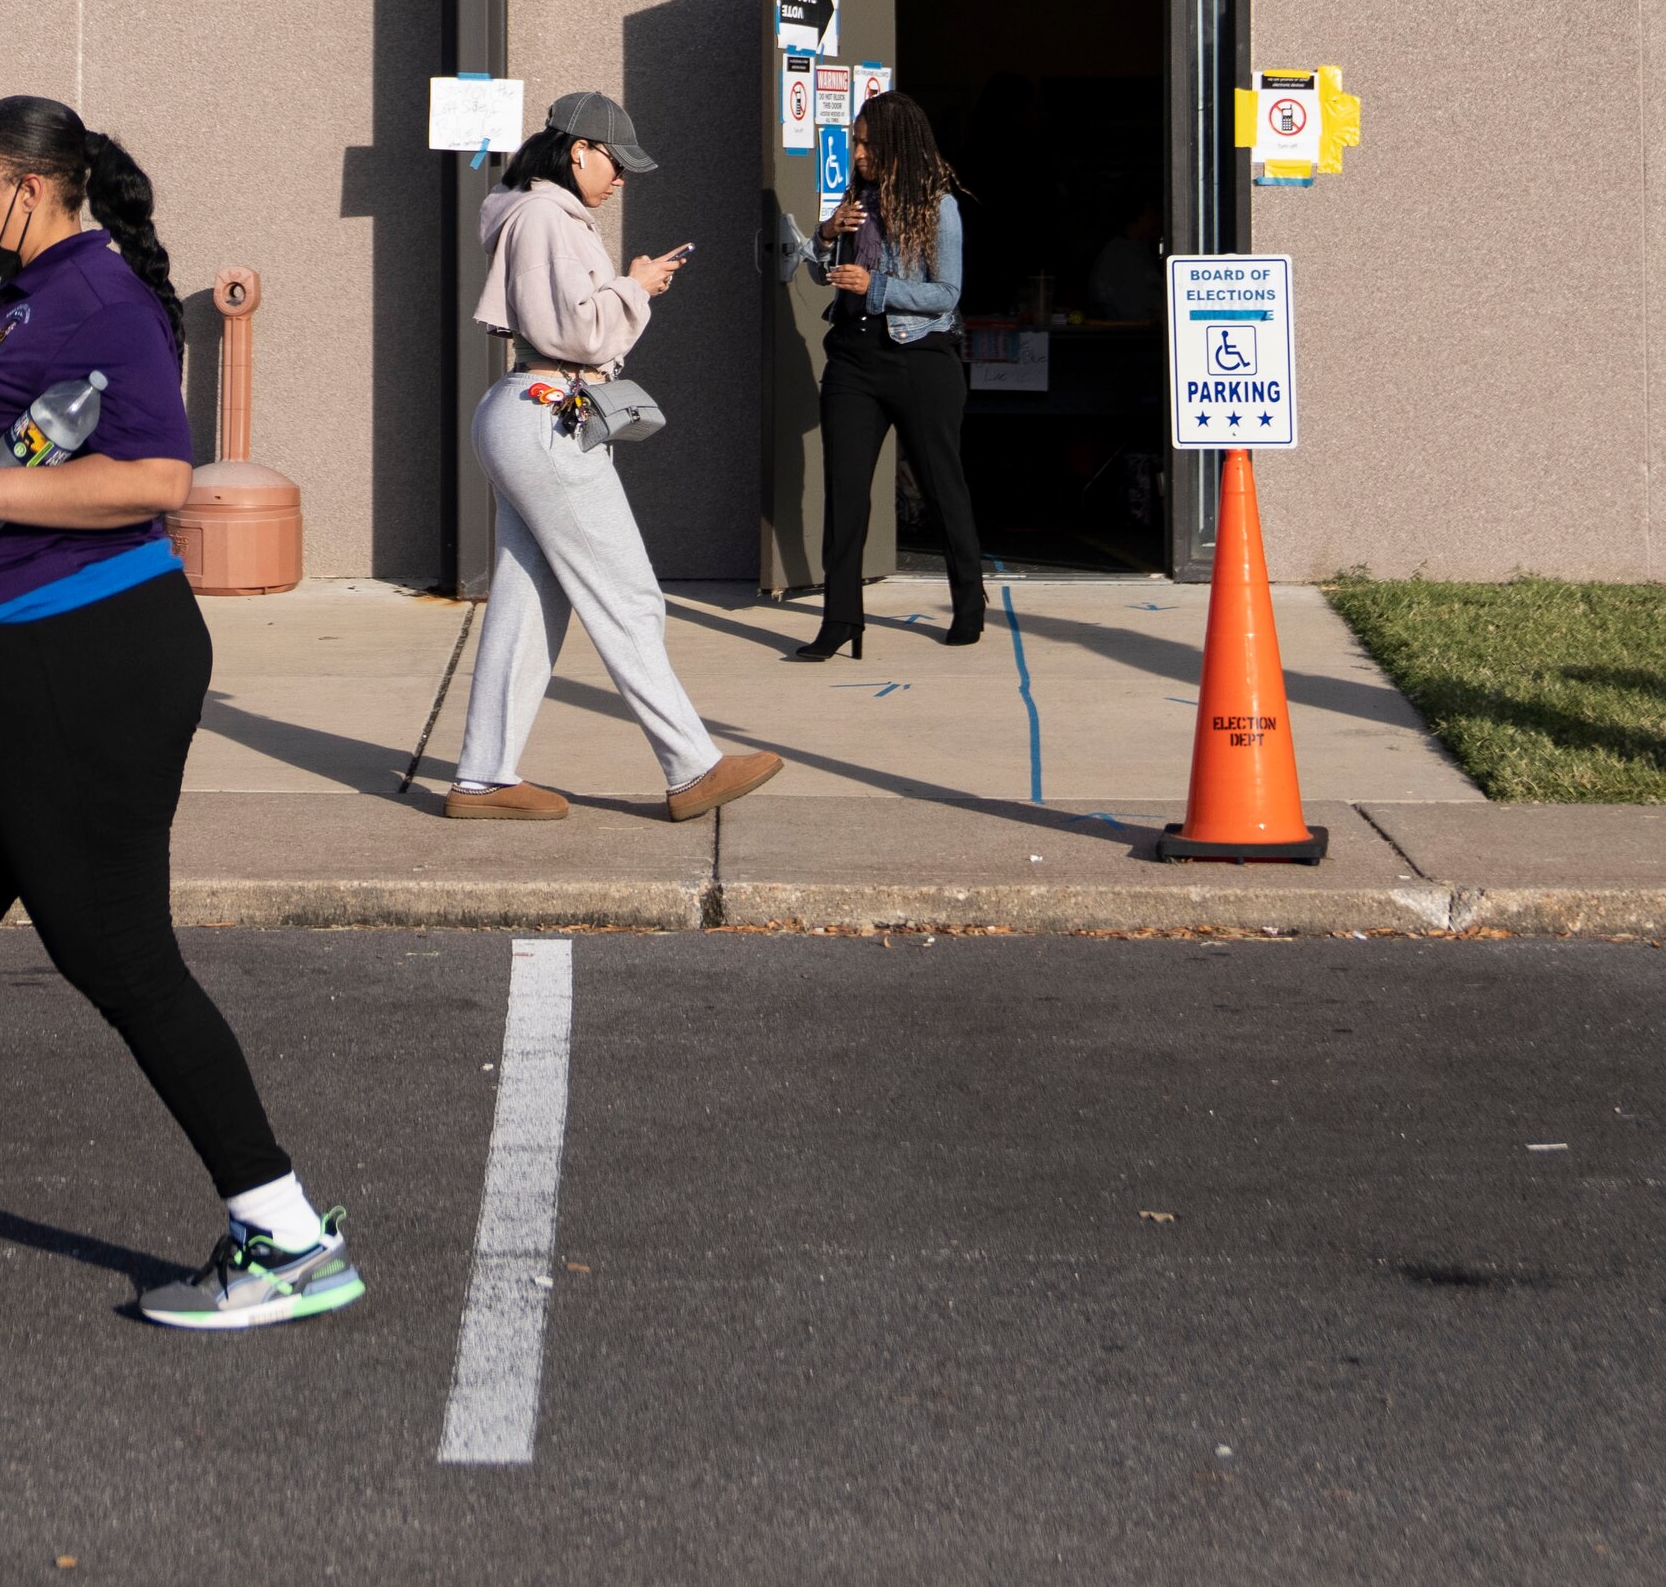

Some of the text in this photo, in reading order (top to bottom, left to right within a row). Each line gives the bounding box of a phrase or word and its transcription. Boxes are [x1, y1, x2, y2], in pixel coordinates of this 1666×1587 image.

[781, 5, 804, 19] VOTE
[817, 71, 848, 91] WARNING
[1190, 269, 1271, 281] BOARD OF
[1186, 289, 1276, 301] ELECTIONS
[1188, 381, 1281, 403] PARKING
[1213, 717, 1276, 730] ELECTION
[1230, 733, 1264, 746] DEPT
